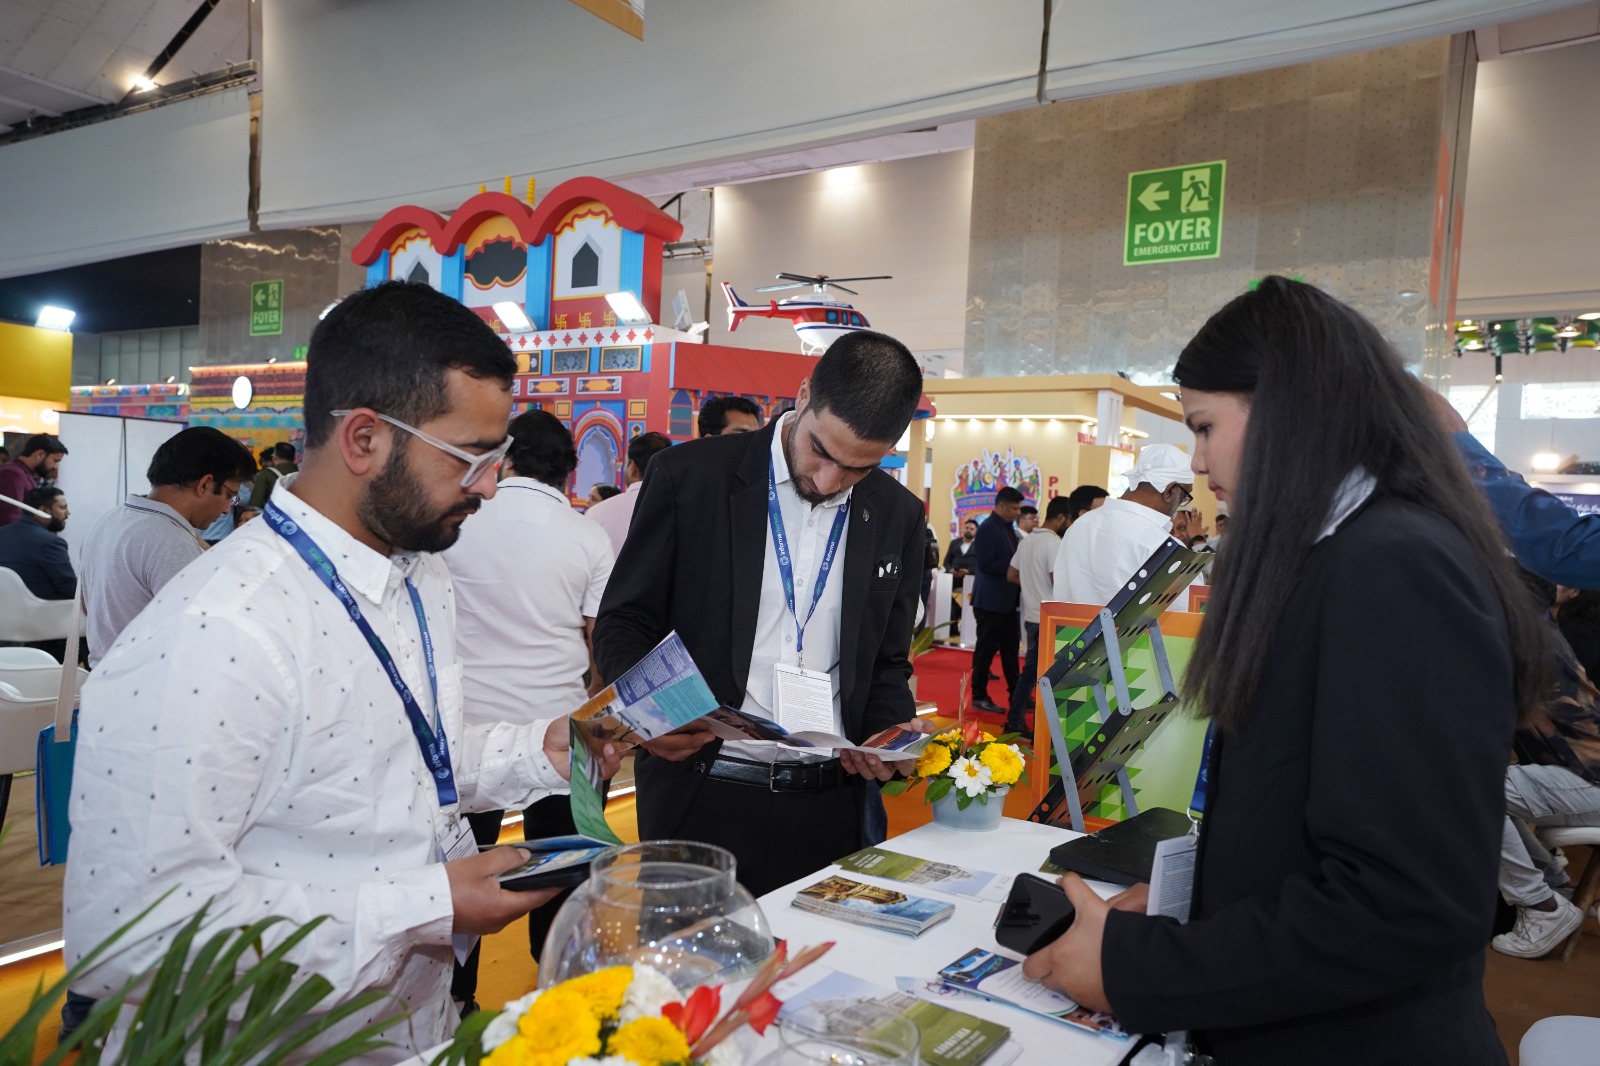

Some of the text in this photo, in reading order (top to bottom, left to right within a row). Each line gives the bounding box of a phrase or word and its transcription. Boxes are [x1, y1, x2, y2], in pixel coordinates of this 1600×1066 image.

[1133, 216, 1212, 245] FOYER
[1133, 241, 1211, 257] EMERGENCY EXIT
[254, 311, 279, 324] FOYER
